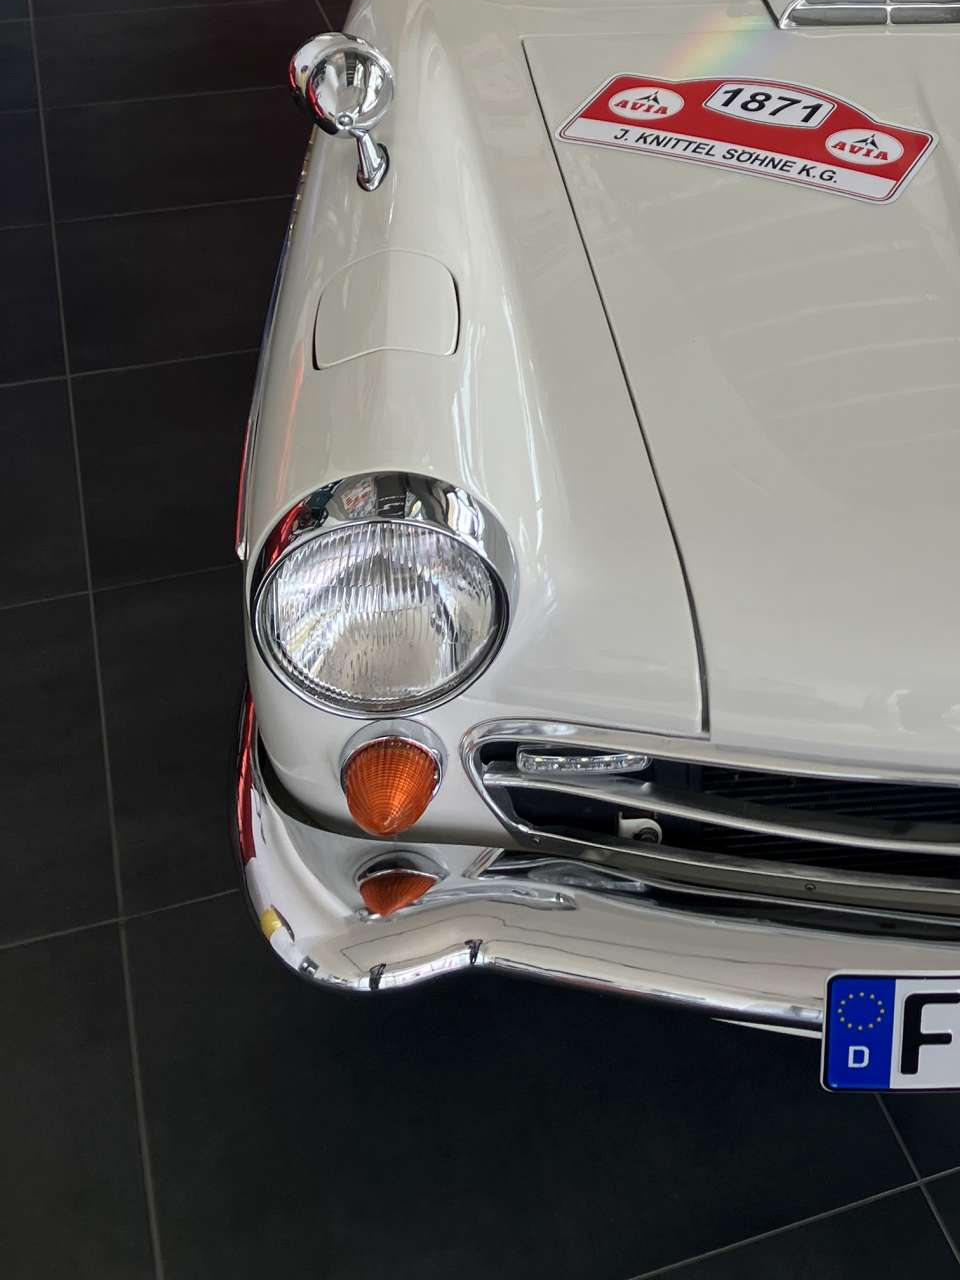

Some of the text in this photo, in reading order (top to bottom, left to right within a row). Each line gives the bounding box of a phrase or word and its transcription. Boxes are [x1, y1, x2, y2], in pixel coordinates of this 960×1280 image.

[613, 99, 670, 115] AVIA
[721, 87, 824, 123] 1871
[613, 128, 838, 183] J. KNITTEL SÖHNE K.G.
[831, 139, 889, 161] AVIA
[848, 1046, 870, 1068] D
